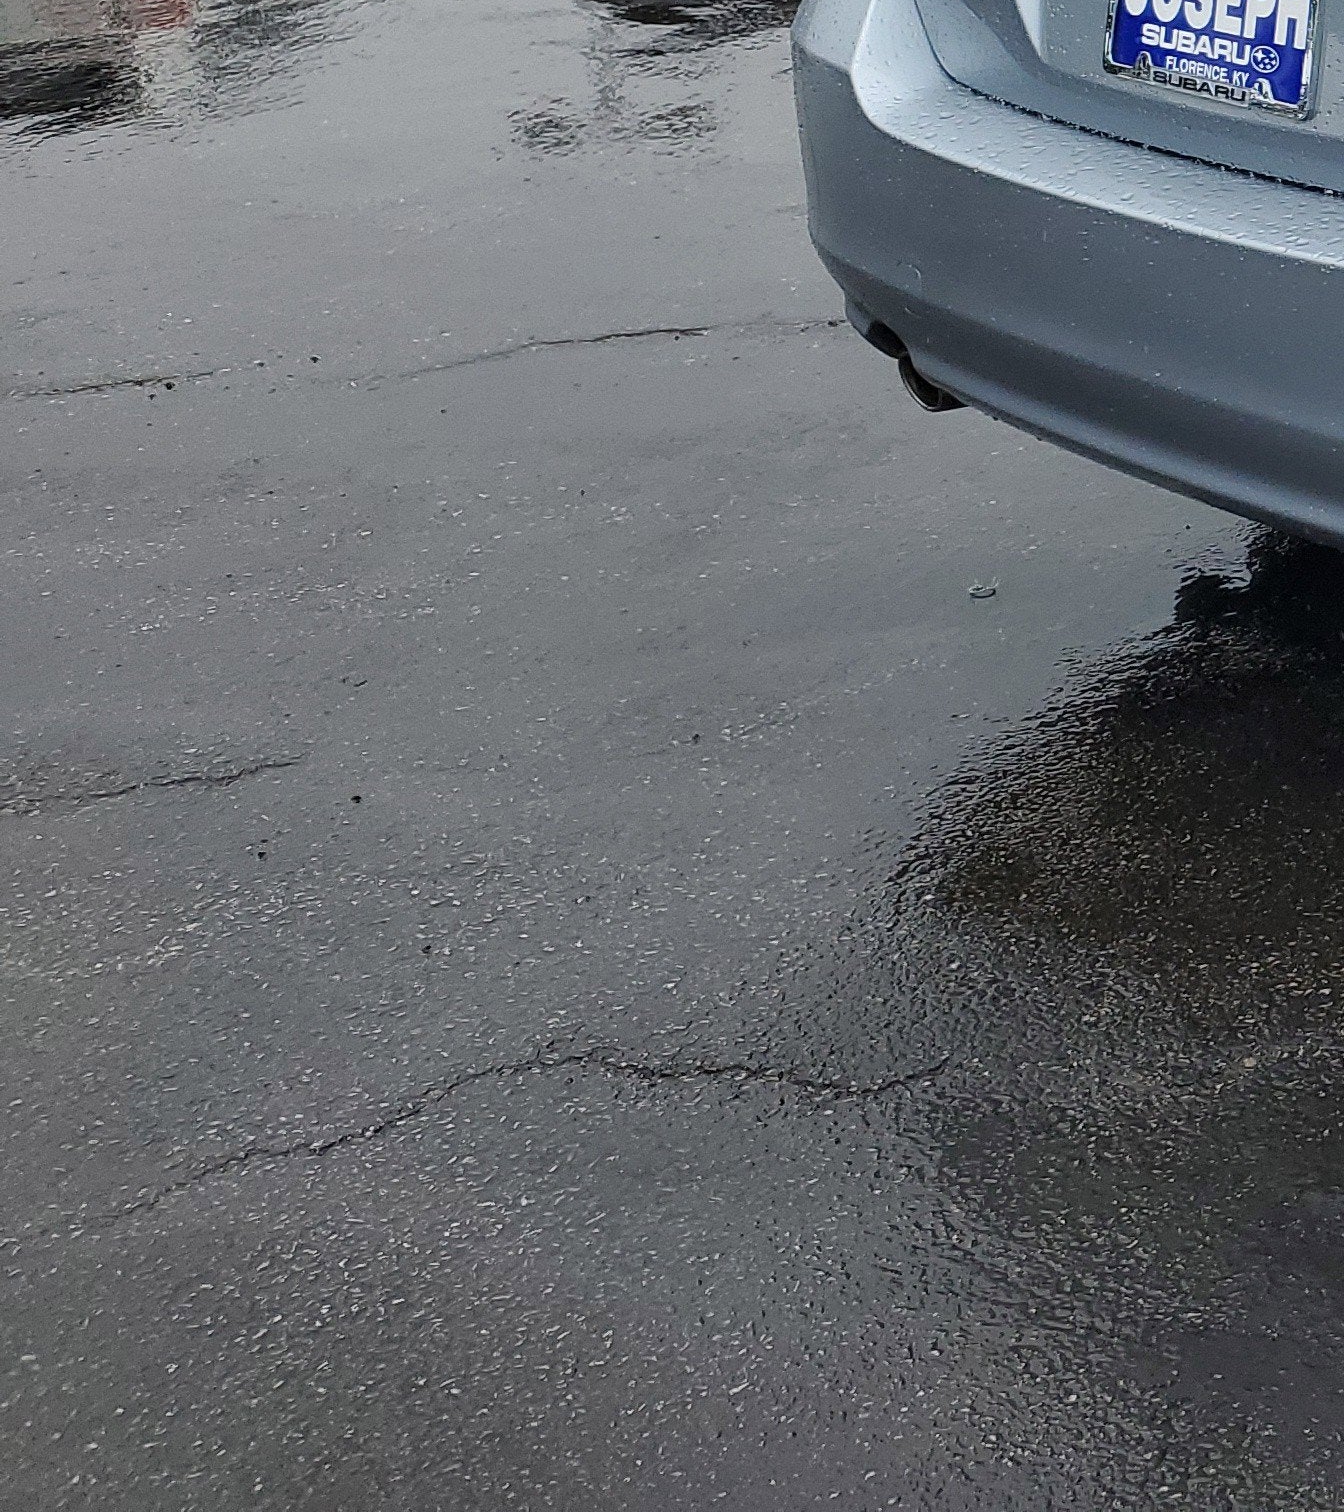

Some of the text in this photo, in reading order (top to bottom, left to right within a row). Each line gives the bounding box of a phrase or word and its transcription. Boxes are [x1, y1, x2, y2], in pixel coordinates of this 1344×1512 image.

[1141, 22, 1252, 67] SUBARU
[1152, 70, 1247, 102] SUBARU
[1232, 70, 1250, 88] KY
